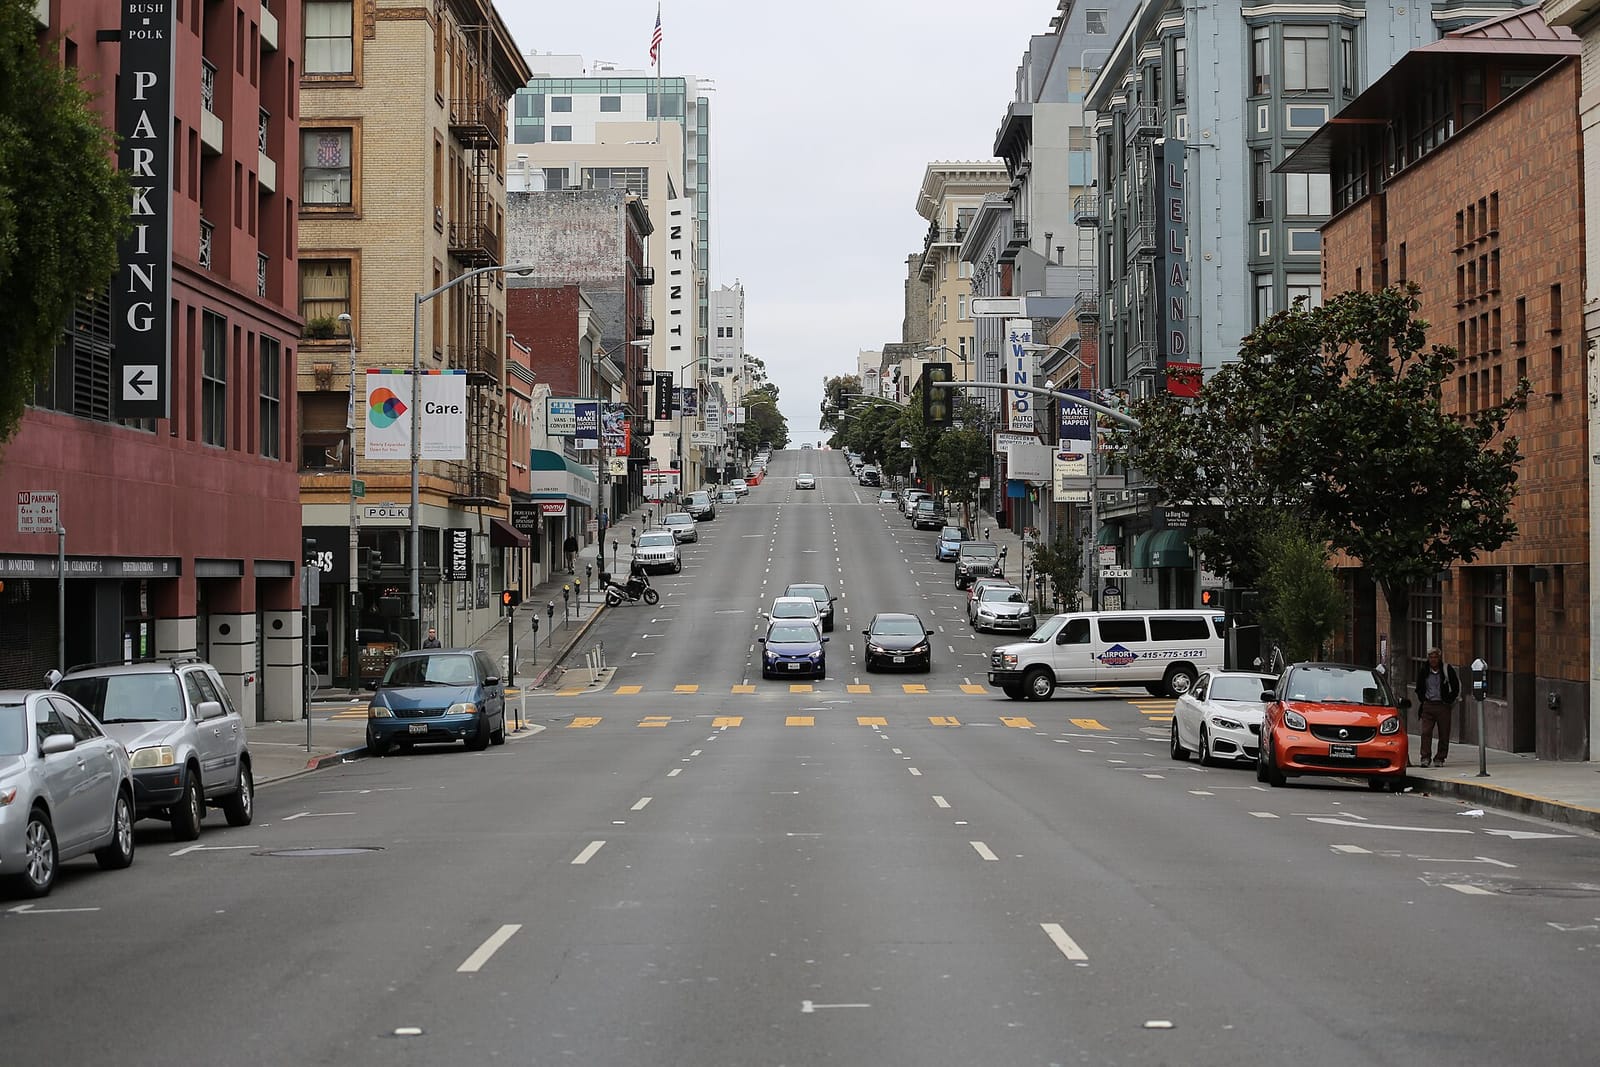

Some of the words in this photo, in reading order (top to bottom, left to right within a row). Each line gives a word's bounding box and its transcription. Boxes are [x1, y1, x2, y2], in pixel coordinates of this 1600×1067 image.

[130, 4, 163, 13] BUSH
[129, 30, 162, 40] POLK
[127, 71, 158, 332] PARKING
[1169, 162, 1186, 355] LELAND
[670, 210, 681, 351] INFINITI
[424, 401, 462, 414] Care.
[1062, 408, 1088, 416] MAKE
[19, 492, 30, 504] NO
[32, 495, 56, 504] PARKING
[370, 508, 404, 516] POLK
[453, 530, 466, 570] PEOPLES
